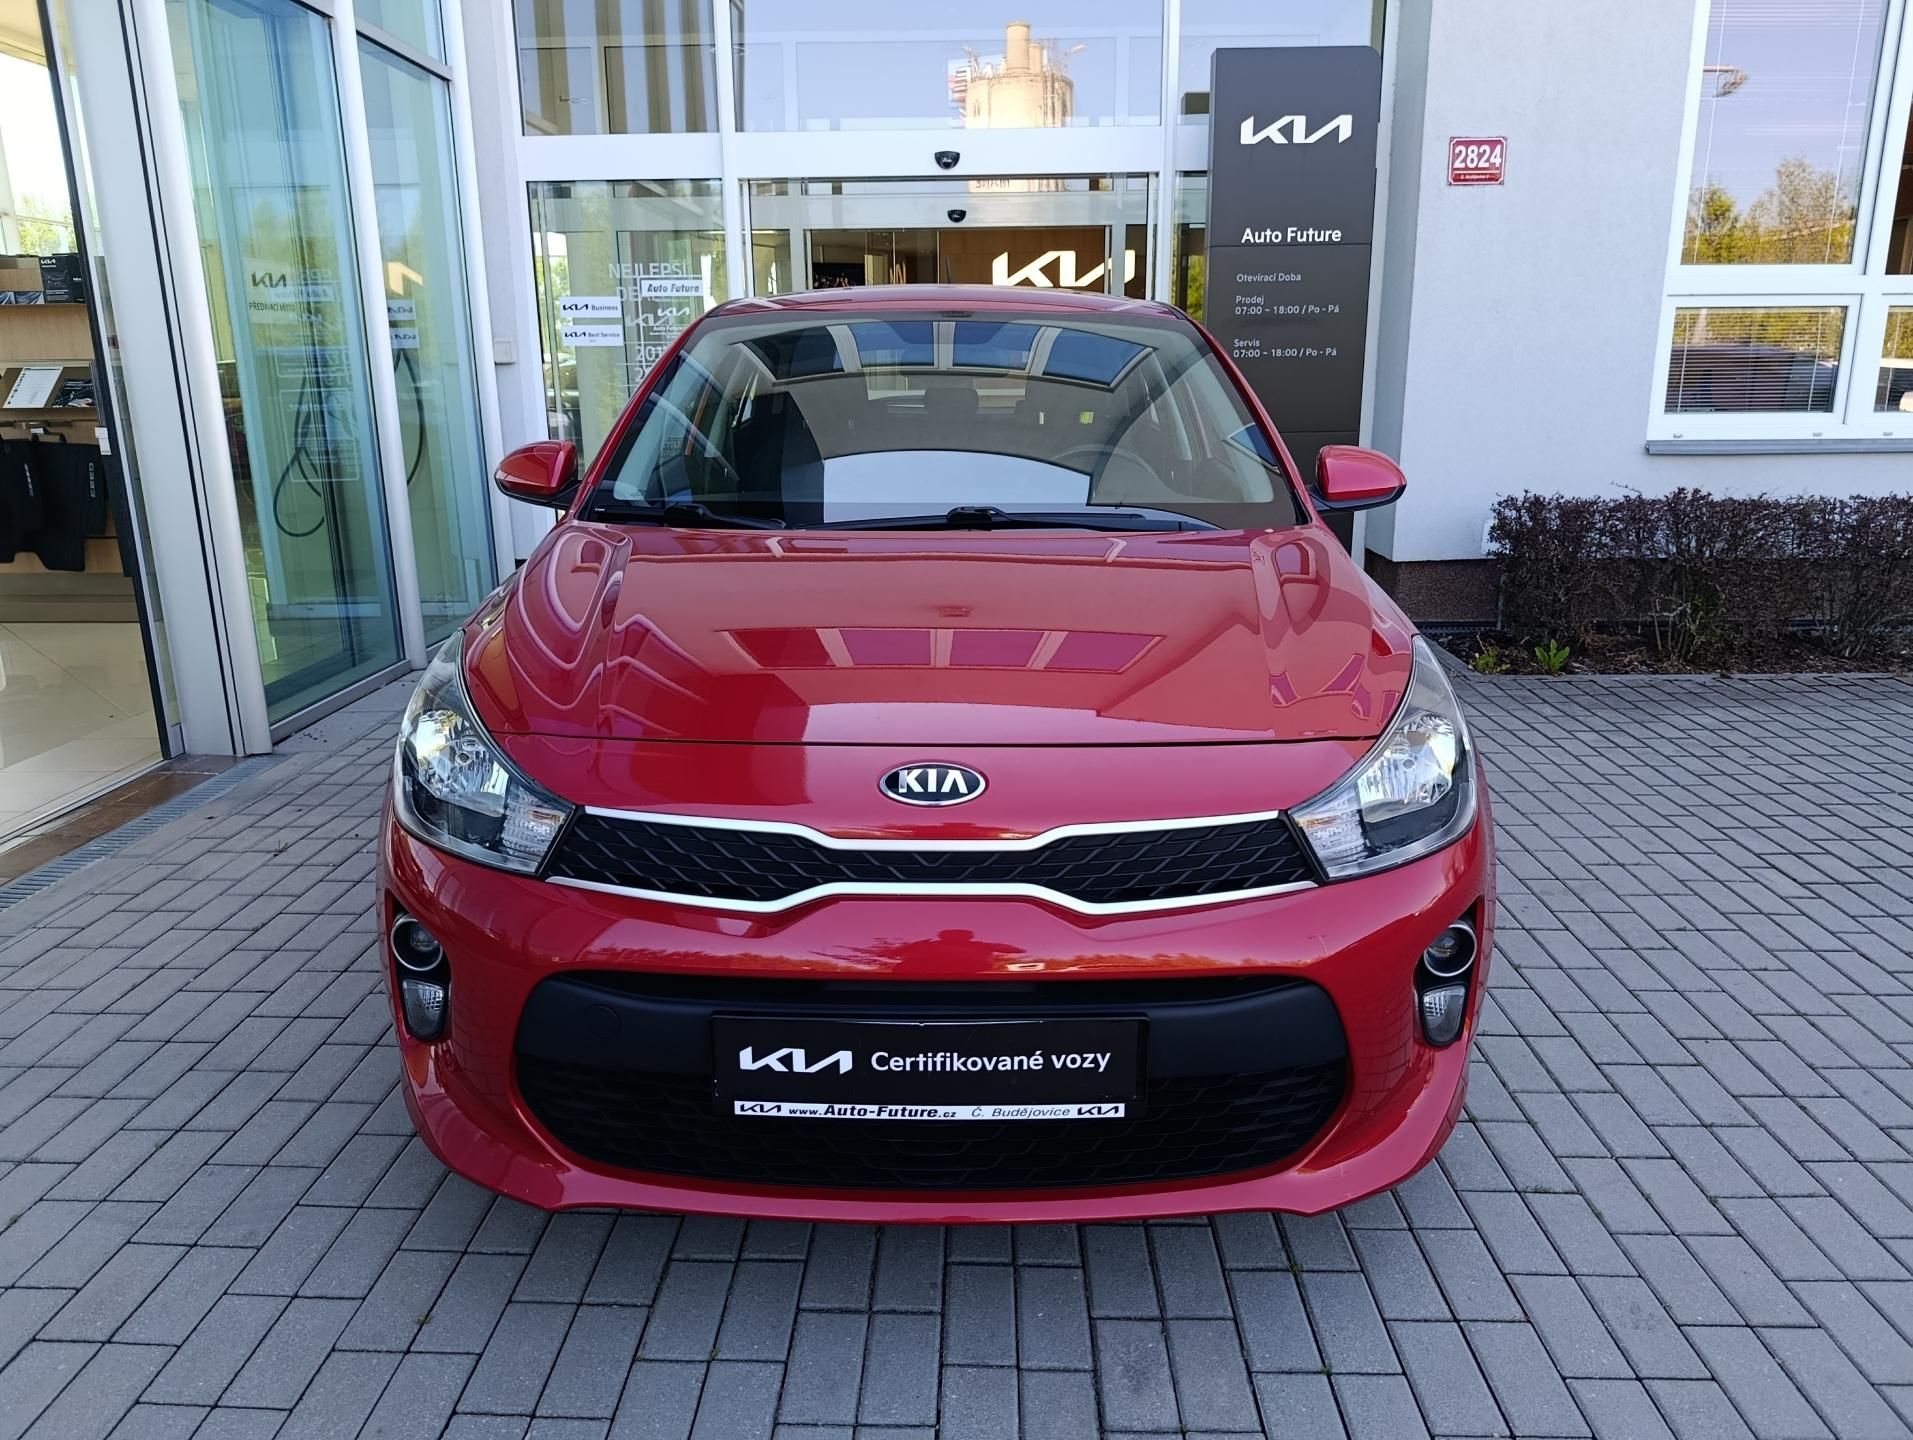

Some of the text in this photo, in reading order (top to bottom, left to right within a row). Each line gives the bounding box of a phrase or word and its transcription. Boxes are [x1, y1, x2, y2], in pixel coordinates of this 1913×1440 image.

[1240, 114, 1353, 144] KIA
[1453, 144, 1502, 168] 2824
[1241, 226, 1342, 243] Auto Future
[992, 249, 1136, 287] KIA
[251, 271, 288, 288] KIA
[1278, 272, 1302, 281] Doba
[647, 283, 700, 293] Auto Future
[562, 303, 589, 311] KIA
[1235, 295, 1265, 305] Prodej
[1235, 306, 1263, 315] 07:00
[1273, 305, 1300, 314] 18:00
[1308, 305, 1320, 314] Po
[1328, 304, 1340, 313] Pá
[1233, 339, 1260, 347] Servis
[1233, 349, 1260, 358] 07:00
[1271, 348, 1298, 357] 18:00
[1306, 348, 1318, 357] Po
[1325, 347, 1337, 356] Pá
[898, 768, 968, 794] KIA
[739, 1046, 1111, 1075] KIA Certifikované vozy
[740, 1104, 1120, 1120] KIA www.Auto-Future.cz Č. Budějovice KIA
